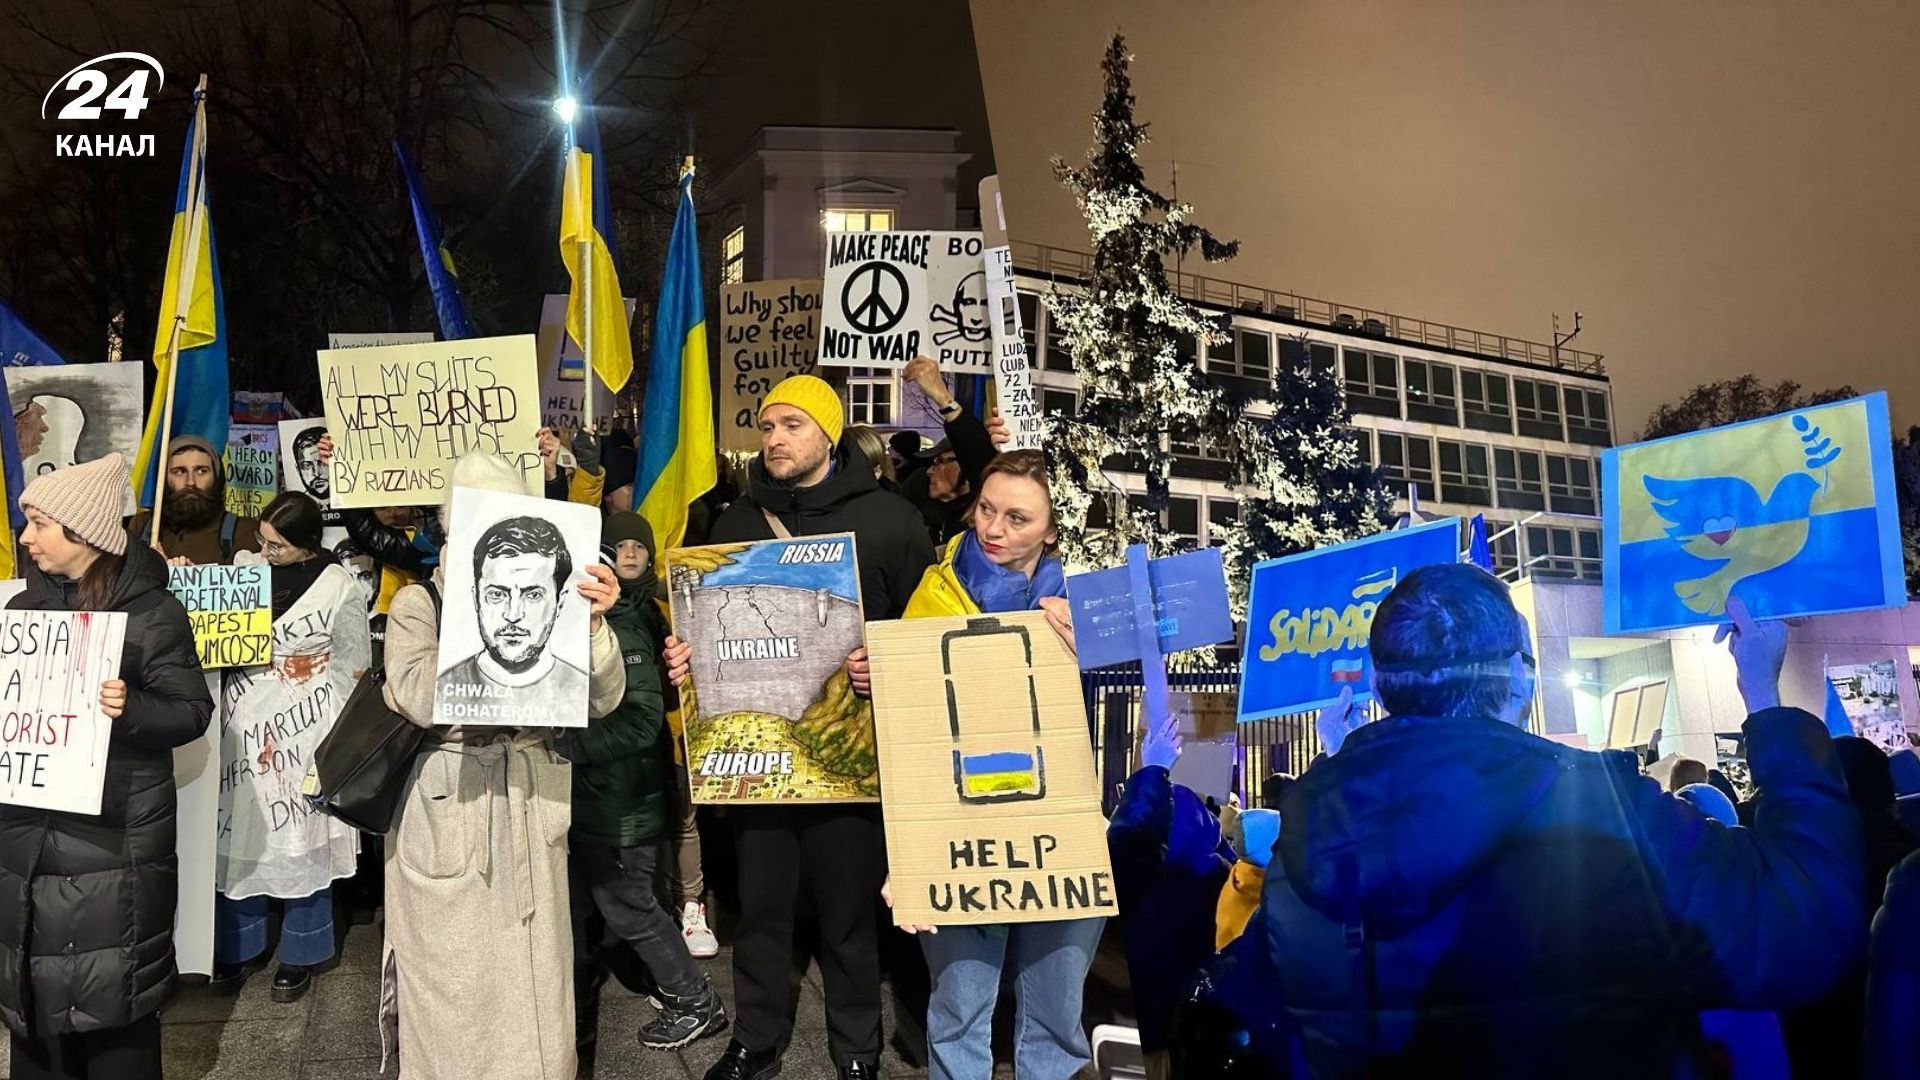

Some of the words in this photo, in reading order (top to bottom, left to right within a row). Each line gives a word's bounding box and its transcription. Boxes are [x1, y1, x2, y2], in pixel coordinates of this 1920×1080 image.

[830, 235, 877, 268] MAKE
[881, 235, 931, 269] PEACE
[948, 237, 983, 256] BO
[996, 249, 1011, 264] TE
[727, 290, 771, 322] Why
[777, 286, 824, 314] shou
[727, 325, 761, 343] we
[769, 316, 815, 342] feel
[823, 326, 862, 359] NOT
[868, 330, 920, 361] WAR
[734, 343, 819, 375] Guilty
[940, 348, 992, 366] PUTI
[326, 364, 364, 400] ALL
[381, 361, 411, 397] MY
[1003, 374, 1022, 387] 72
[336, 396, 408, 430] WERE
[418, 386, 518, 427] BURNED
[547, 395, 585, 413] HEL
[235, 448, 273, 464] HERO!
[333, 428, 385, 462] WITH
[393, 425, 423, 459] MY
[227, 463, 274, 486] OWARD
[334, 461, 361, 494] BY
[779, 542, 844, 565] RUSSIA
[169, 567, 205, 588] ANY
[186, 586, 268, 611] BETRAYAL
[1, 620, 69, 656] SSiA
[188, 611, 256, 635] DAPEST
[272, 608, 333, 646] RKIV
[1259, 601, 1381, 661] SOLiDAR
[221, 635, 270, 665] COST?
[717, 636, 800, 661] UKRAINE
[5, 669, 21, 702] A
[2, 711, 77, 747] ORiST
[244, 682, 334, 755] MARIUP
[0, 750, 51, 788] ATE
[219, 744, 301, 794] HERSON
[701, 751, 793, 776] EUROPE
[949, 834, 1057, 870] HELP
[929, 871, 1114, 913] UKRAINE
